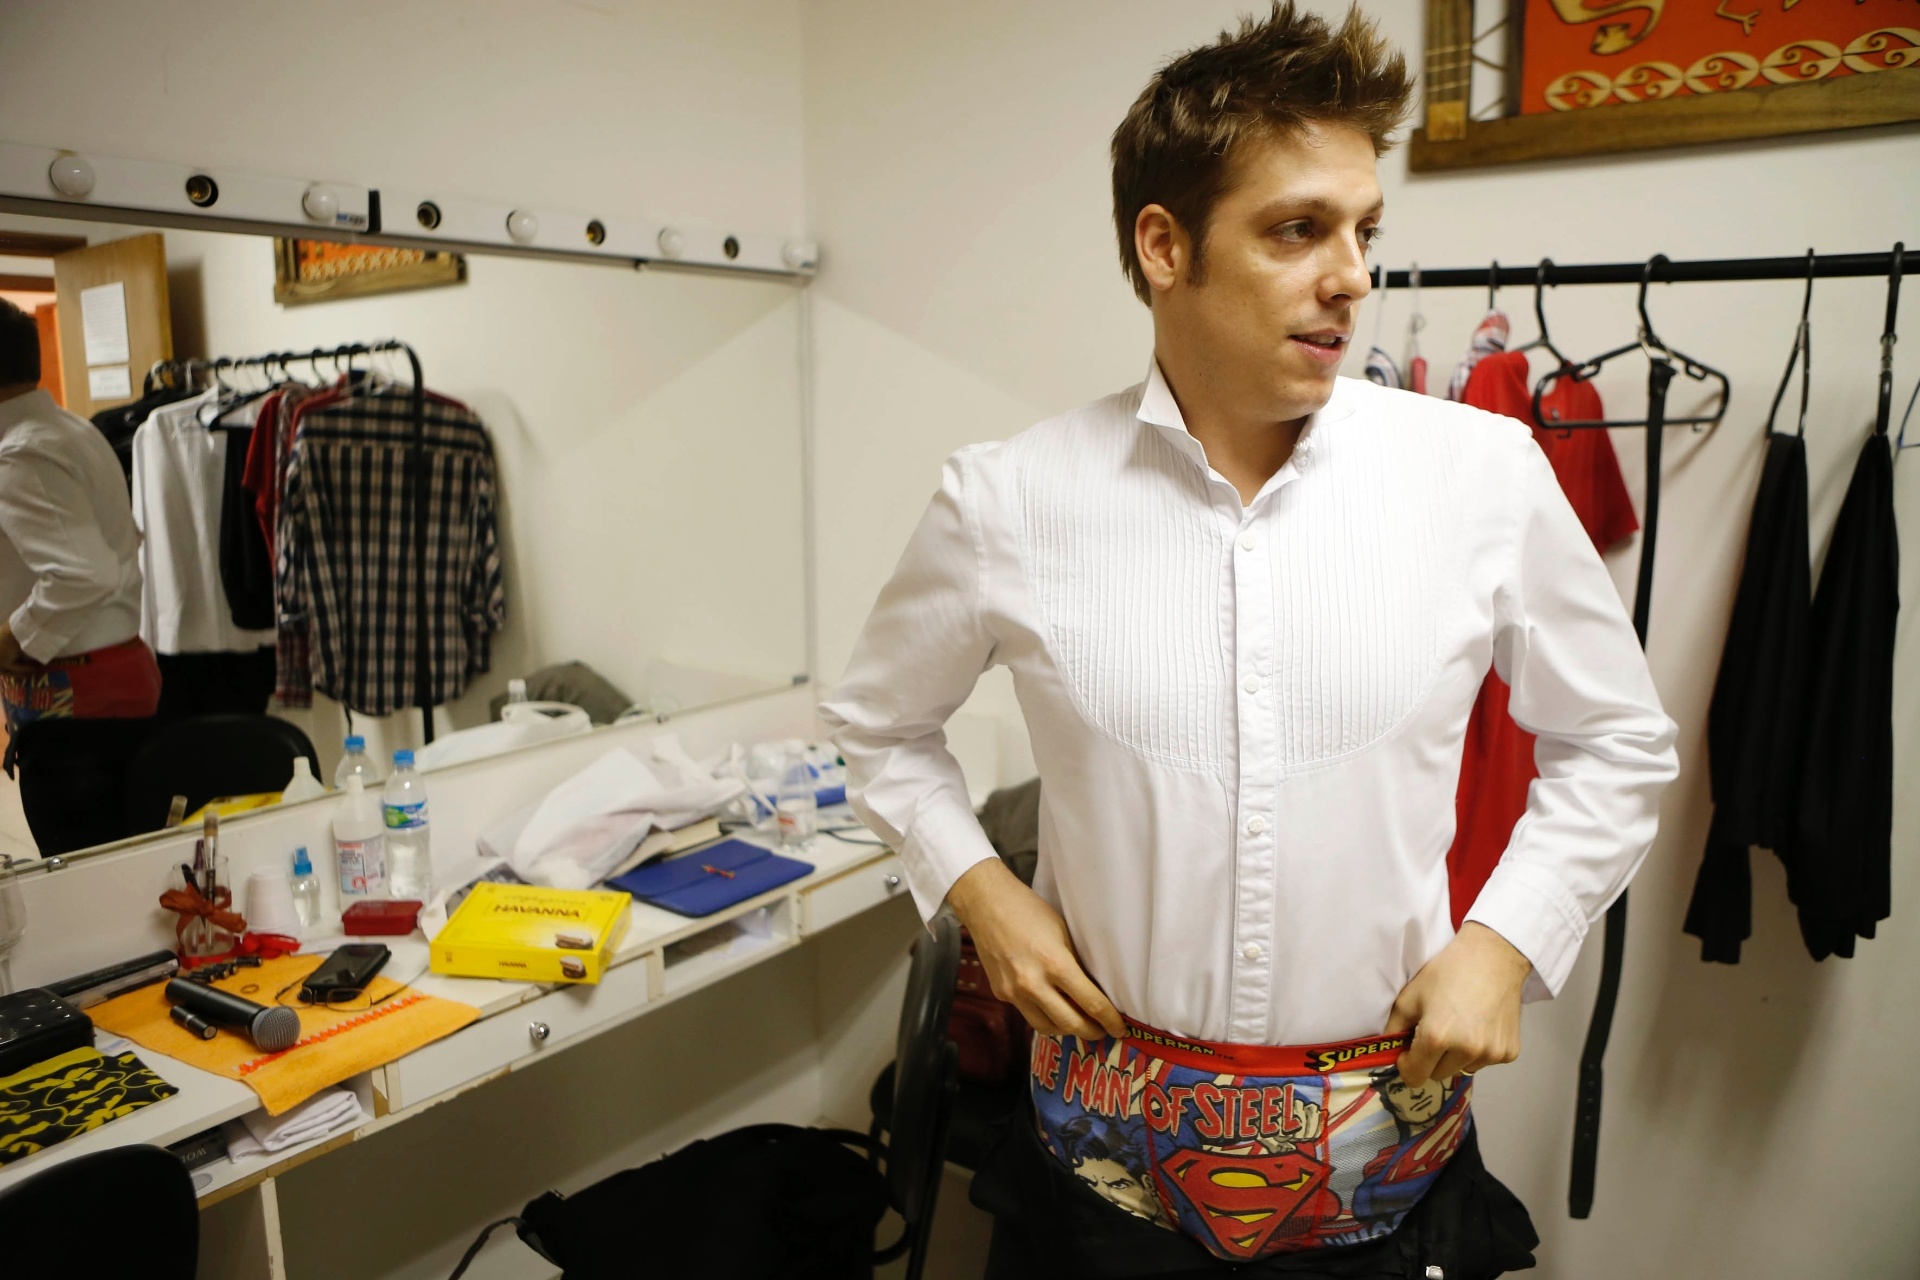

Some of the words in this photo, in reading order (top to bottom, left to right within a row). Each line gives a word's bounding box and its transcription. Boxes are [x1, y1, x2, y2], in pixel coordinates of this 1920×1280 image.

[493, 904, 581, 918] HAVANNA
[1032, 1034, 1062, 1090] HE
[1063, 1050, 1132, 1121] MAN
[1141, 1082, 1194, 1137] OF
[1193, 1081, 1303, 1139] STEEL
